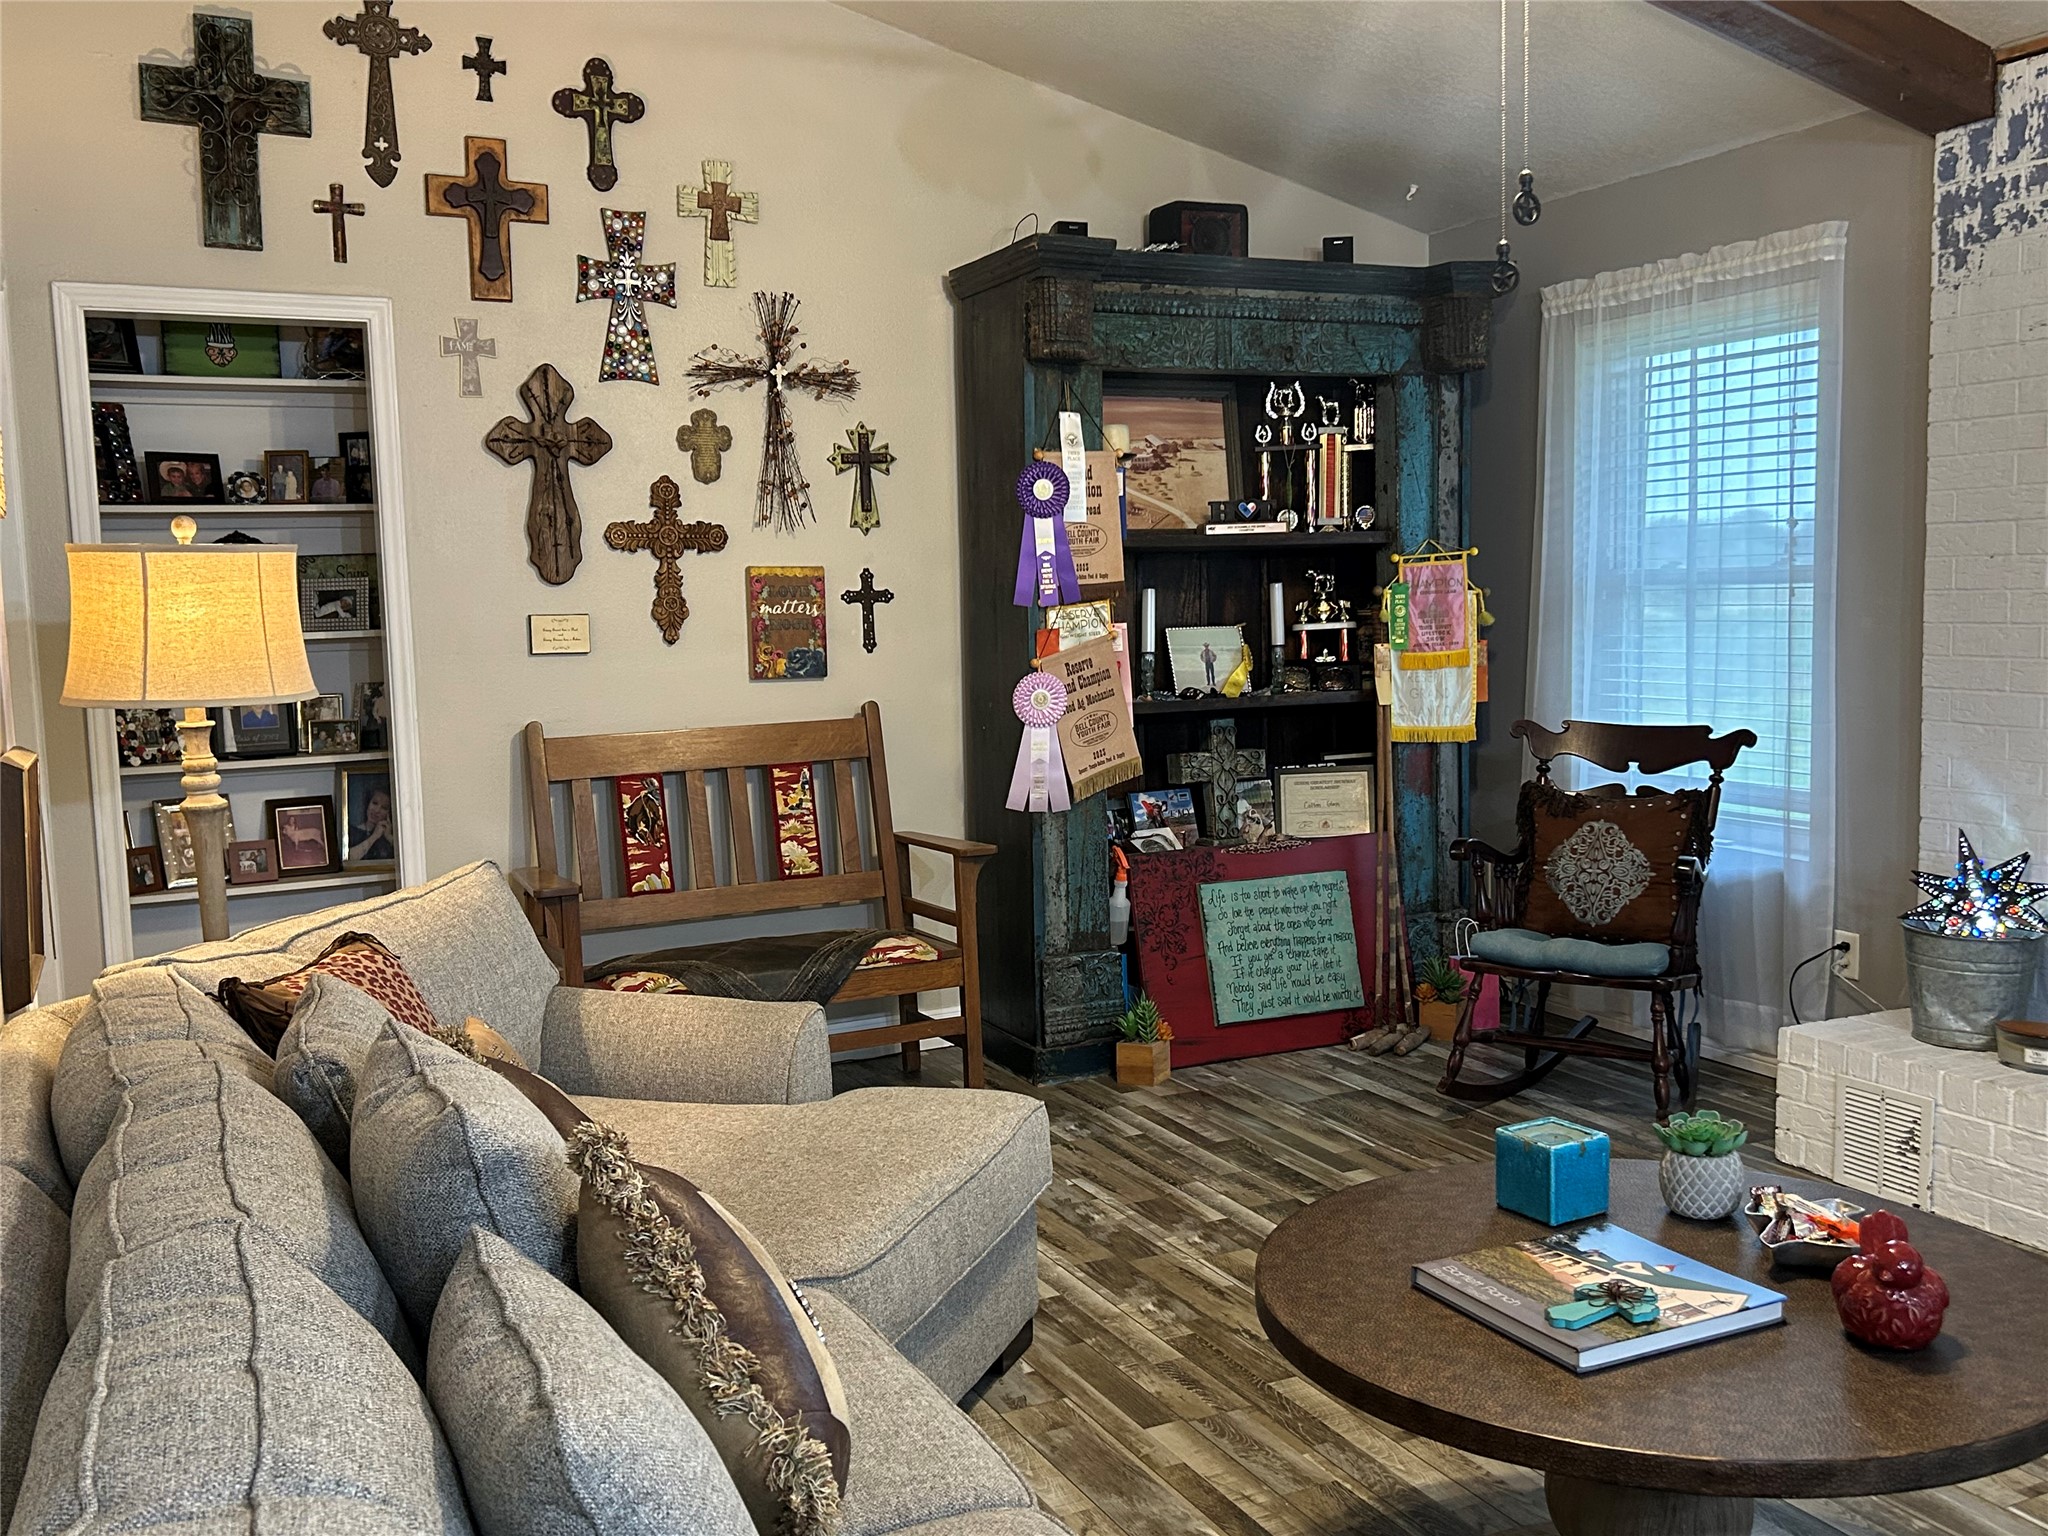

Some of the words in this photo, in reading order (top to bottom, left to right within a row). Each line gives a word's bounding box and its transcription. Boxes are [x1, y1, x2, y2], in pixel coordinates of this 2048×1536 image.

[1067, 530, 1076, 538] ELL
[1077, 529, 1099, 538] COUNTY
[1085, 537, 1099, 545] FAIR
[769, 585, 810, 598] LOVE
[759, 599, 821, 617] matters
[769, 618, 811, 631] MOST
[1064, 657, 1093, 677] Reserve
[1077, 668, 1111, 690] Champion
[1085, 687, 1115, 706] Mechanics
[1074, 722, 1088, 733] BELL
[1088, 713, 1110, 727] COUNTY
[1076, 726, 1096, 739] YOUTH
[1097, 720, 1111, 731] FAIR
[1208, 888, 1226, 908] Life
[1231, 892, 1238, 902] is
[1240, 887, 1251, 903] too
[1254, 886, 1271, 901] short
[1273, 886, 1280, 899] to
[1281, 885, 1298, 900] wake
[1300, 885, 1307, 898] up
[1309, 881, 1321, 897] with
[1322, 880, 1344, 898] regrets
[1218, 907, 1228, 920] So
[1232, 907, 1242, 919] love
[1244, 906, 1254, 920] the
[1259, 905, 1279, 919] people
[1281, 904, 1292, 917] who
[1293, 902, 1309, 914] treat
[1310, 904, 1321, 918] you
[1323, 898, 1337, 914] right
[1227, 920, 1250, 940] Forget
[1253, 920, 1271, 933] about
[1274, 919, 1285, 932] the
[1287, 920, 1302, 930] ones
[1302, 917, 1316, 929] who
[1217, 940, 1233, 957] And
[1236, 940, 1258, 951] believe
[1261, 935, 1291, 954] everything
[1292, 933, 1317, 949] happens
[1317, 931, 1326, 945] for
[1230, 954, 1242, 967] If
[1248, 954, 1262, 969] you
[1264, 953, 1274, 968] get
[1278, 951, 1283, 960] a
[1312, 946, 1329, 958] take
[1331, 944, 1336, 955] it
[1233, 967, 1244, 979] If
[1248, 969, 1254, 978] it
[1256, 966, 1283, 981] changes
[1286, 963, 1302, 980] your
[1323, 959, 1333, 969] let
[1336, 955, 1342, 968] it
[1226, 981, 1254, 999] Nobody
[1258, 980, 1271, 992] said
[1276, 977, 1287, 992] life
[1291, 974, 1311, 988] would
[1315, 973, 1324, 984] be
[1328, 972, 1346, 989] easy
[1232, 998, 1254, 1017] They
[1257, 996, 1275, 1015] just
[1278, 992, 1291, 1007] said
[1295, 992, 1301, 1005] it
[1302, 990, 1321, 1003] would
[1322, 989, 1331, 1002] be
[1332, 989, 1353, 1002] worth
[1481, 1286, 1521, 1307] Ranch
